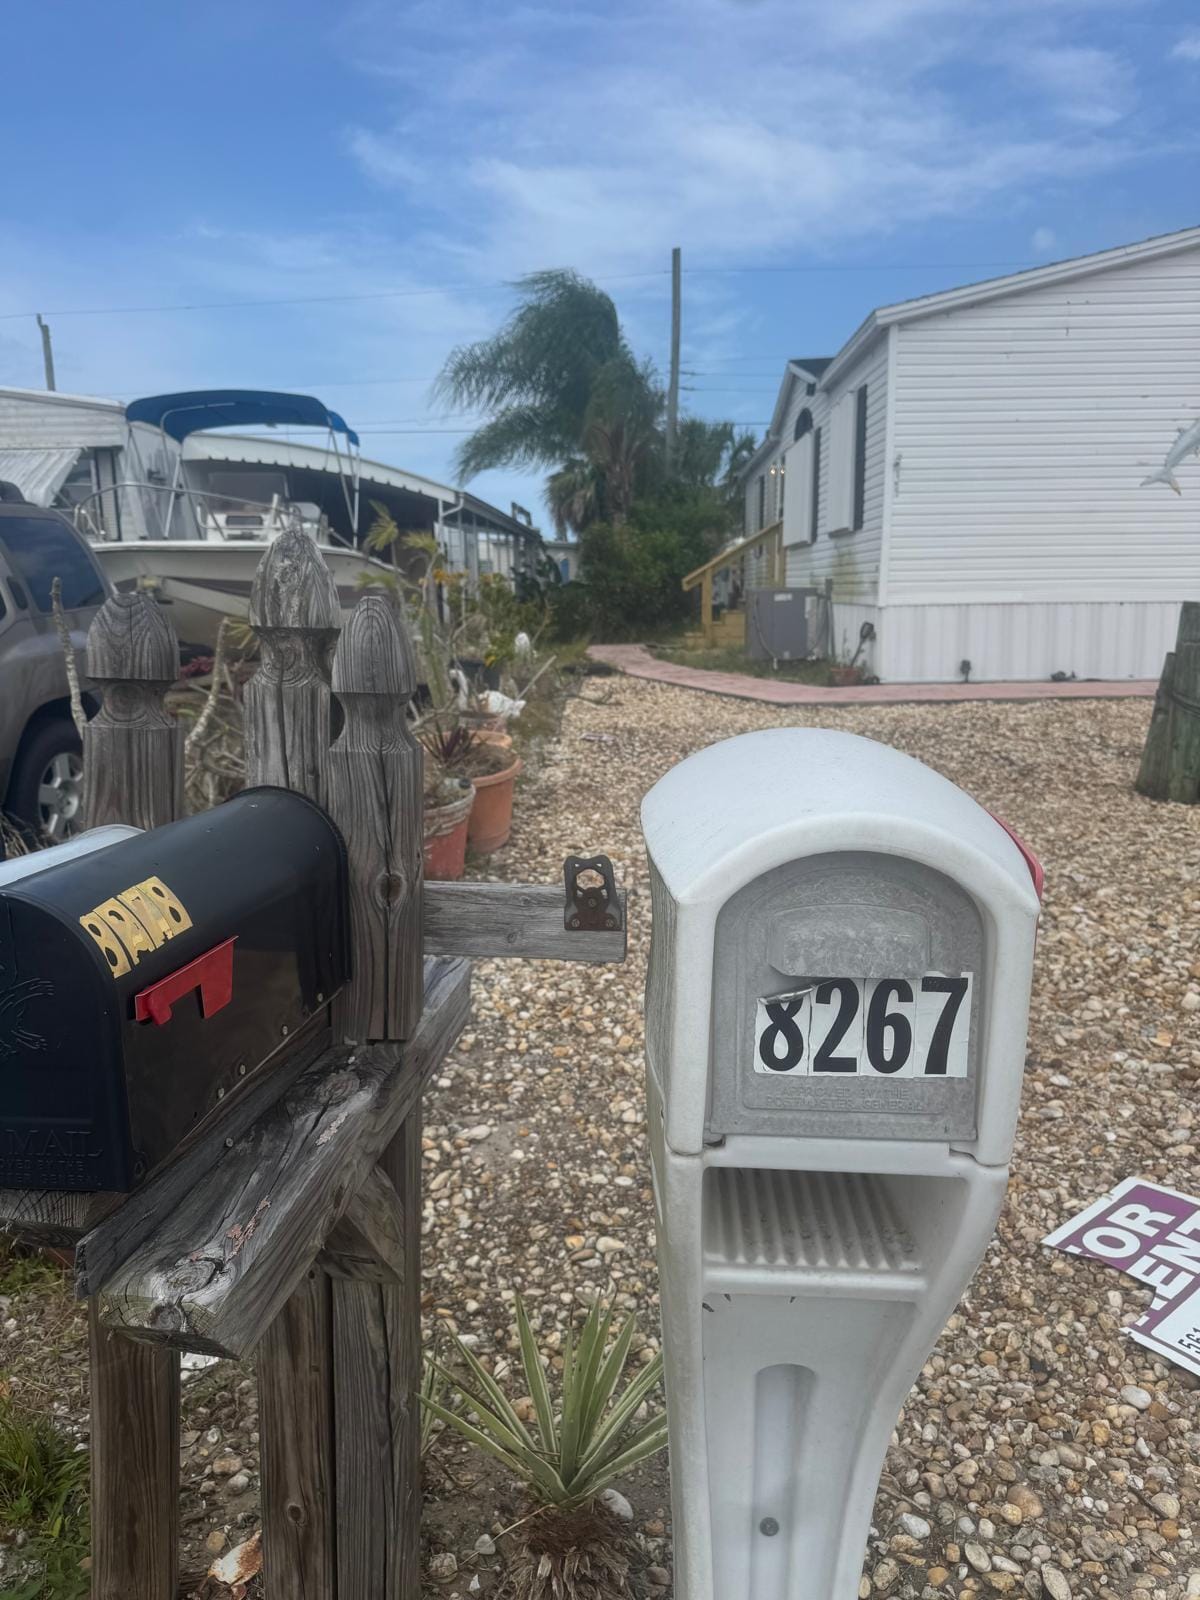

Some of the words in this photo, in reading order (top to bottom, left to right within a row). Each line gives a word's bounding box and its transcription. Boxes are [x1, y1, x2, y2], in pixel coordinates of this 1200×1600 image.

[758, 976, 969, 1075] 8267
[4, 1128, 104, 1157] MAIL
[1065, 1203, 1176, 1258] OR
